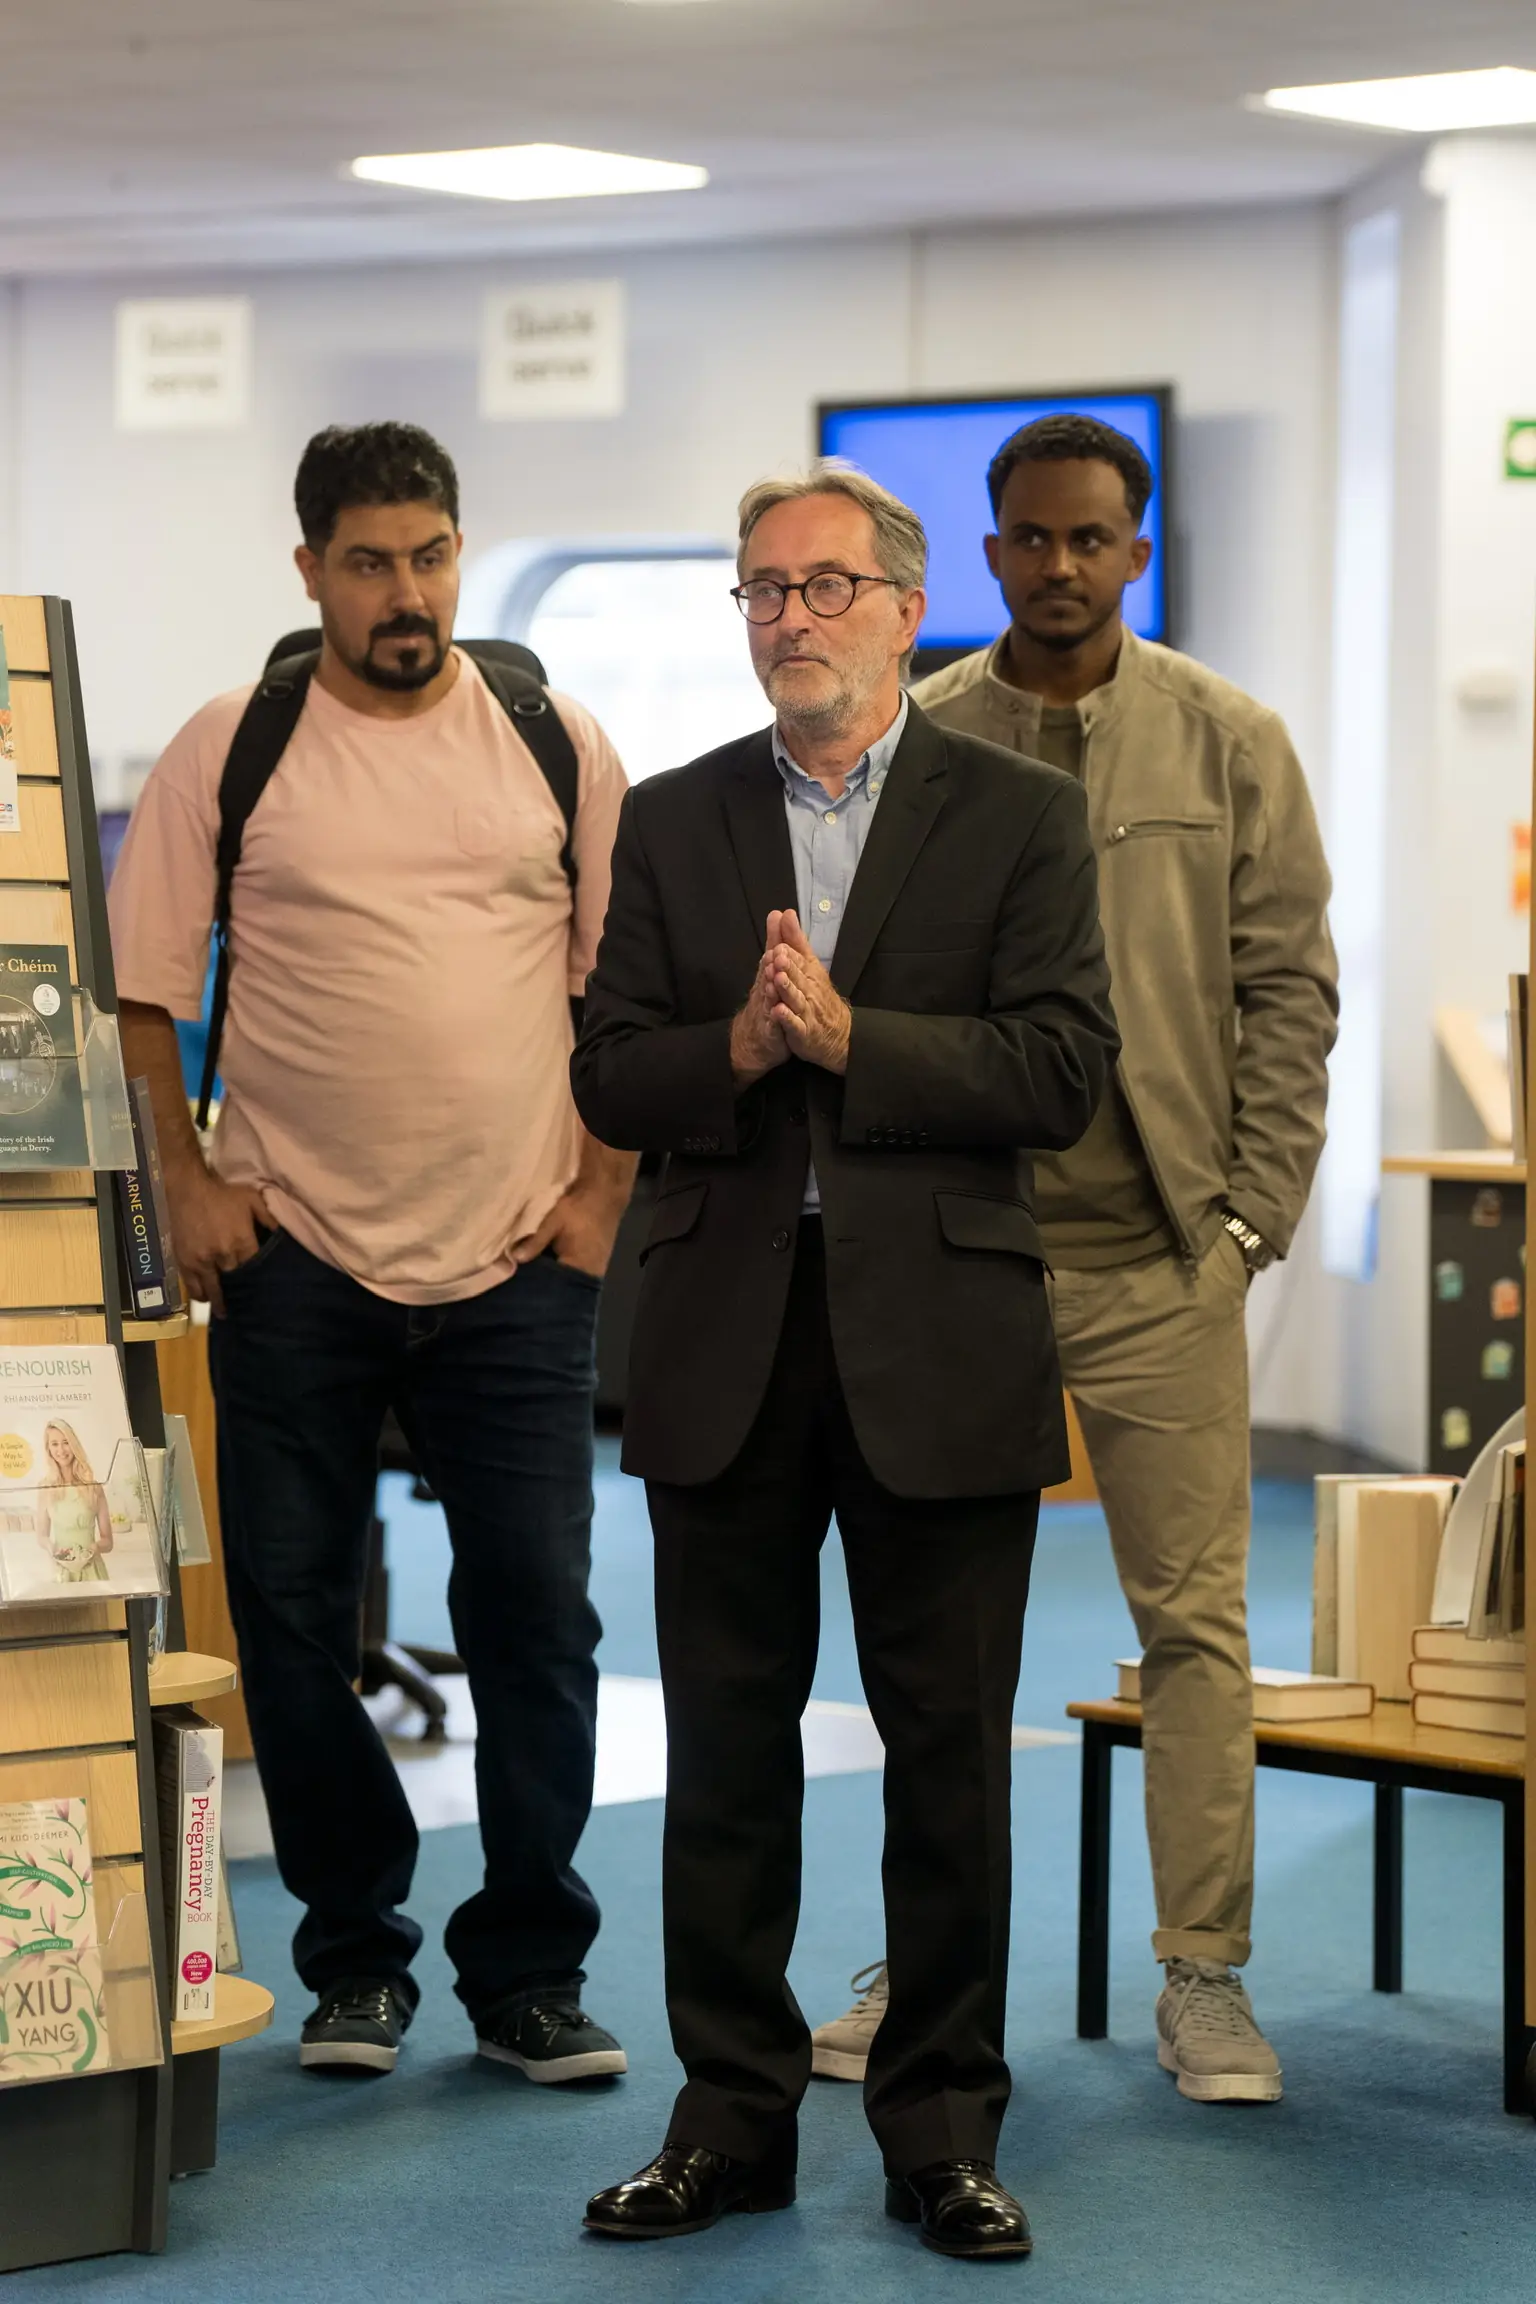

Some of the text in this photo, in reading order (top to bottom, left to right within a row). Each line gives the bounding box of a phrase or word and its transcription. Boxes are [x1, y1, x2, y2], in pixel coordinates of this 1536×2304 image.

[8, 958, 58, 973] Chéim
[29, 1144, 52, 1153] Derry.
[125, 1167, 153, 1276] EARNE COTTON
[4, 1392, 92, 1404] RHIANNON LAMBERT
[184, 1796, 209, 1911] Pregnancy
[204, 1810, 215, 1899] THE DAY-BY-DAY
[187, 1912, 212, 1923] BOOK
[14, 1976, 72, 2019] XIU
[18, 2022, 76, 2047] YANG
